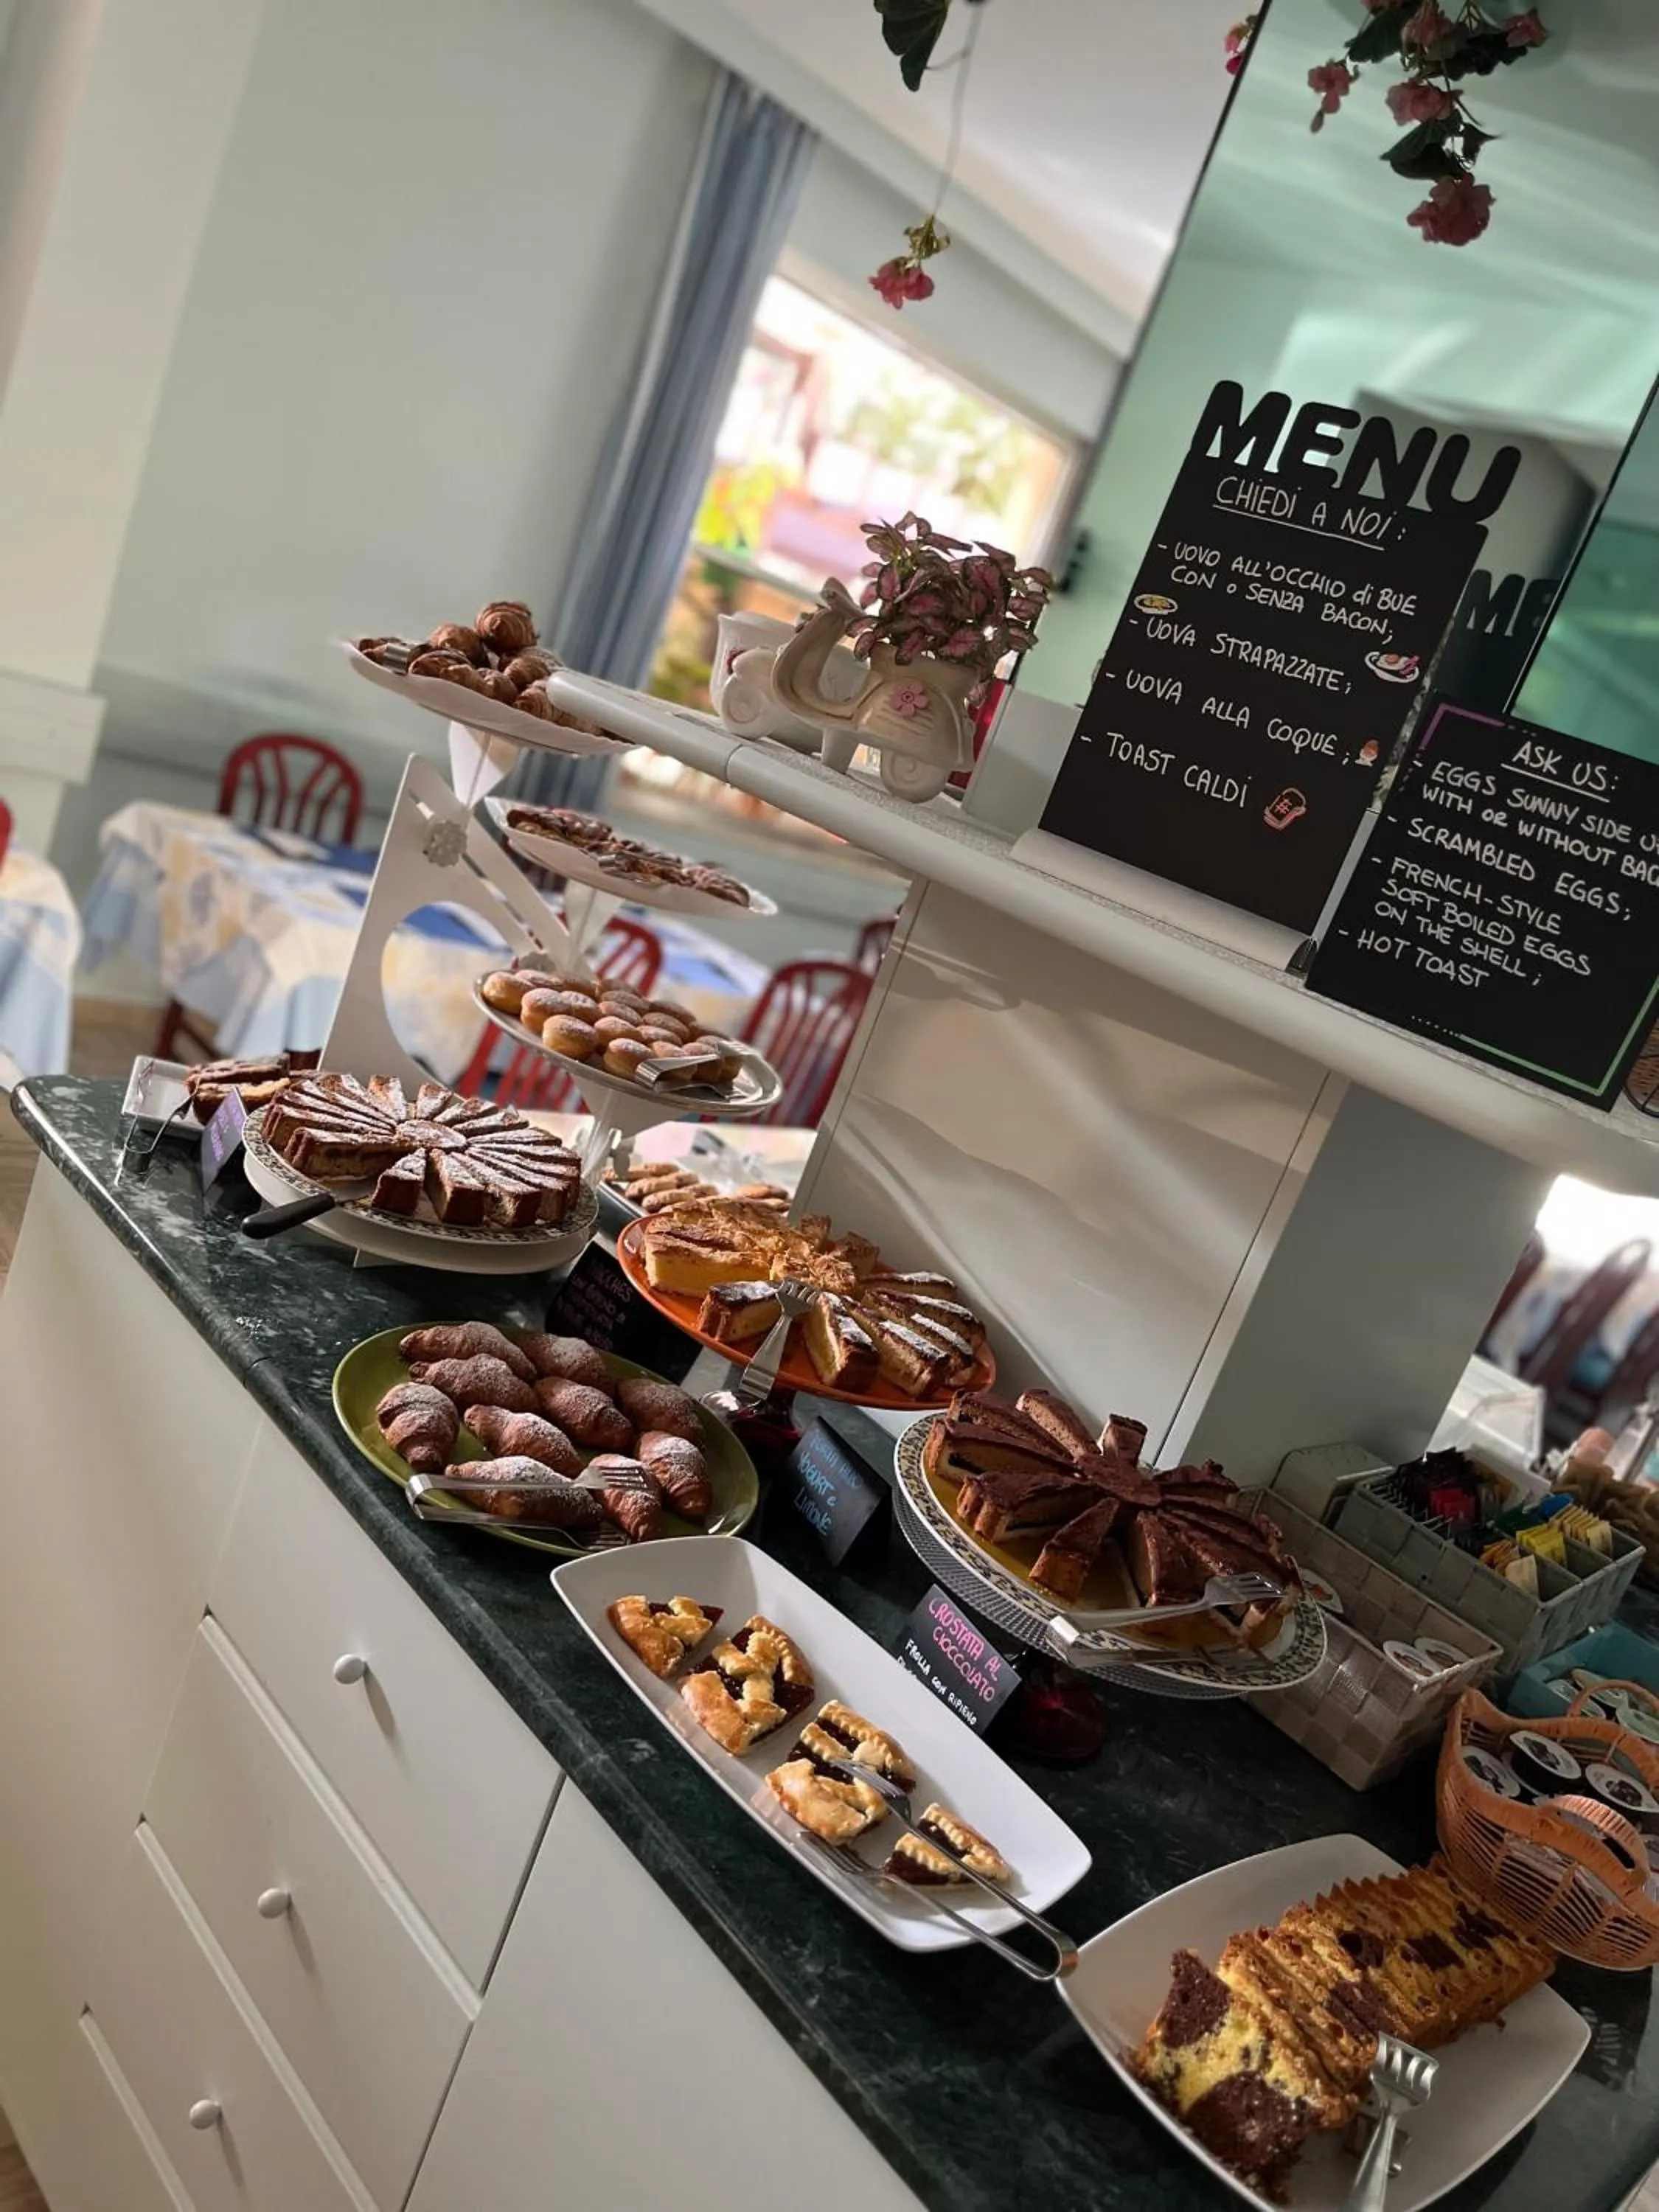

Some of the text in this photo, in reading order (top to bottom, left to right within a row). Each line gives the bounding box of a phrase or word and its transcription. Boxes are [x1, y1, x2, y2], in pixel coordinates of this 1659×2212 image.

[1189, 379, 1522, 525] MENU
[1311, 502, 1326, 526] A
[1171, 565, 1217, 589] CON
[1245, 582, 1304, 613] SENZA
[1321, 602, 1393, 645] BACON;
[1175, 542, 1220, 567] UOVO
[1231, 556, 1346, 598] ALL'OCCHIO
[1377, 588, 1417, 616] BUE
[1147, 616, 1352, 695] UOVA STRAPAZZATE;
[1126, 669, 1182, 705] UOVA
[1201, 697, 1250, 729] ALLA
[1107, 731, 1176, 775] TOAST
[1512, 741, 1562, 775] ASK
[1422, 784, 1472, 815] WITH
[1517, 819, 1617, 866] WITHOUT
[1620, 855, 1659, 887] BAC
[1431, 761, 1496, 796] EGGS
[1506, 788, 1579, 825] SUNNY
[1580, 815, 1632, 843] SIDE
[1408, 818, 1630, 921] SCRAMBLED EGGS;
[1357, 929, 1490, 987] HOT TOAST
[1374, 901, 1408, 925] ON
[1416, 915, 1454, 945] THE
[1381, 878, 1591, 975] SOFT BOILED EGGS
[932, 1625, 995, 1703] CIOCCOLATO
[984, 1655, 1001, 1682] AL
